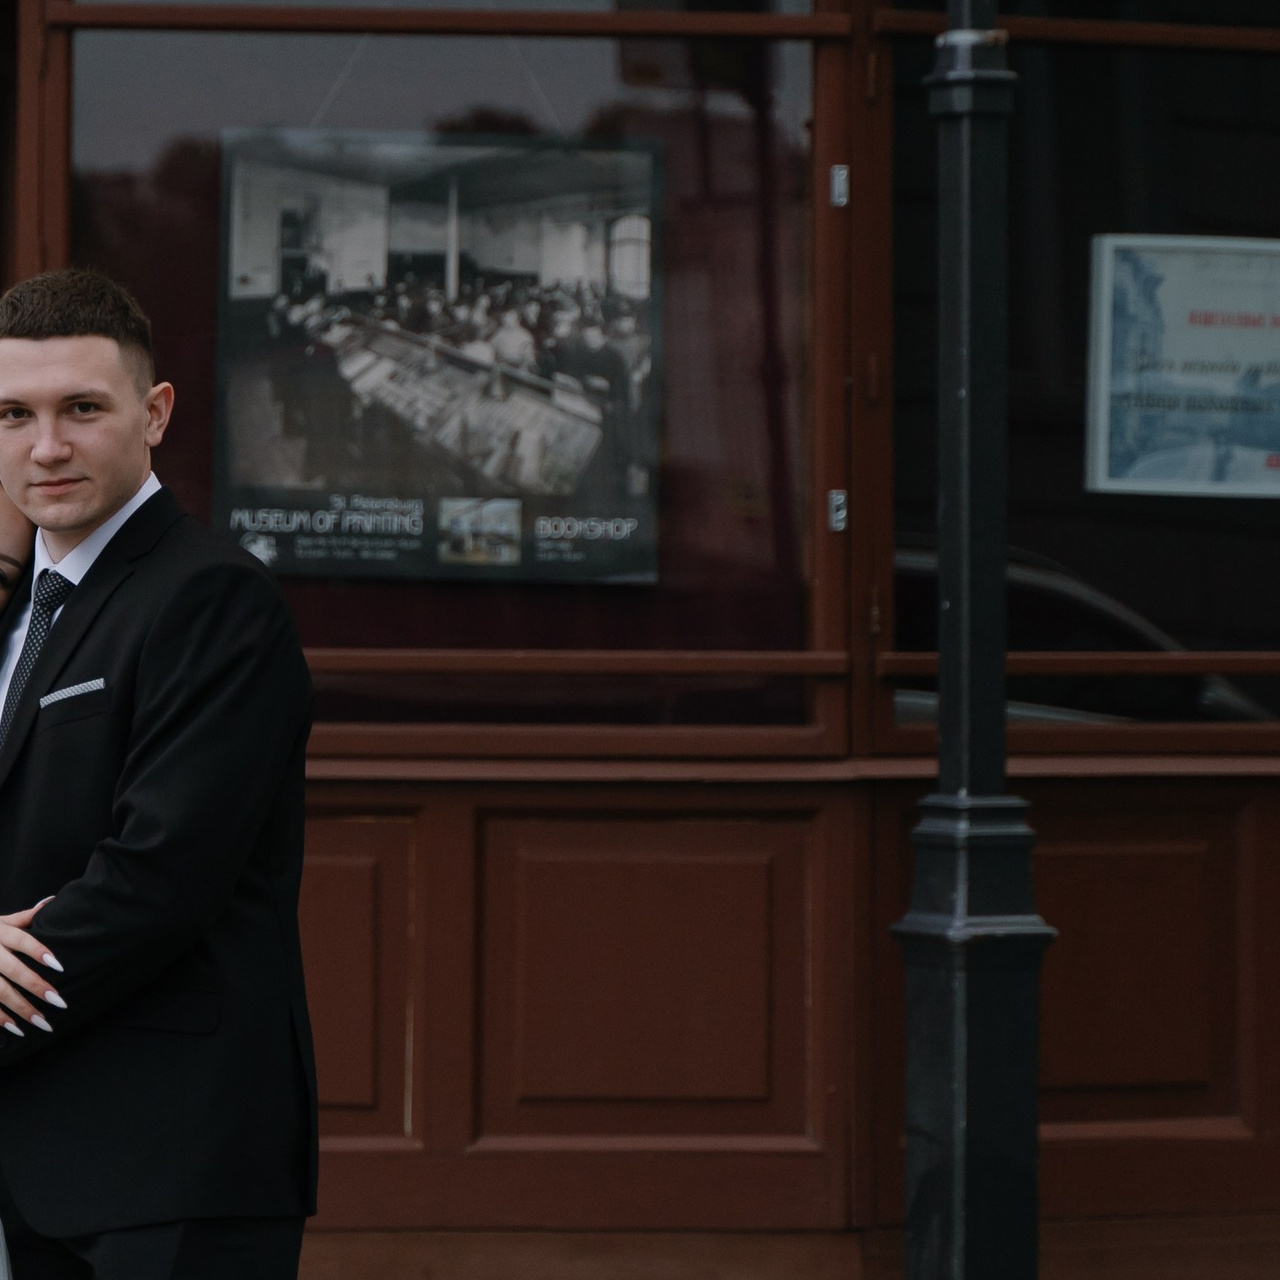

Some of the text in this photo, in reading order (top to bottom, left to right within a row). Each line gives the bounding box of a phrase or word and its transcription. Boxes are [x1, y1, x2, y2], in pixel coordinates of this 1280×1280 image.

[231, 509, 423, 535] MUSEUM OF PRINTING
[535, 517, 638, 539] BOOKSHOP
